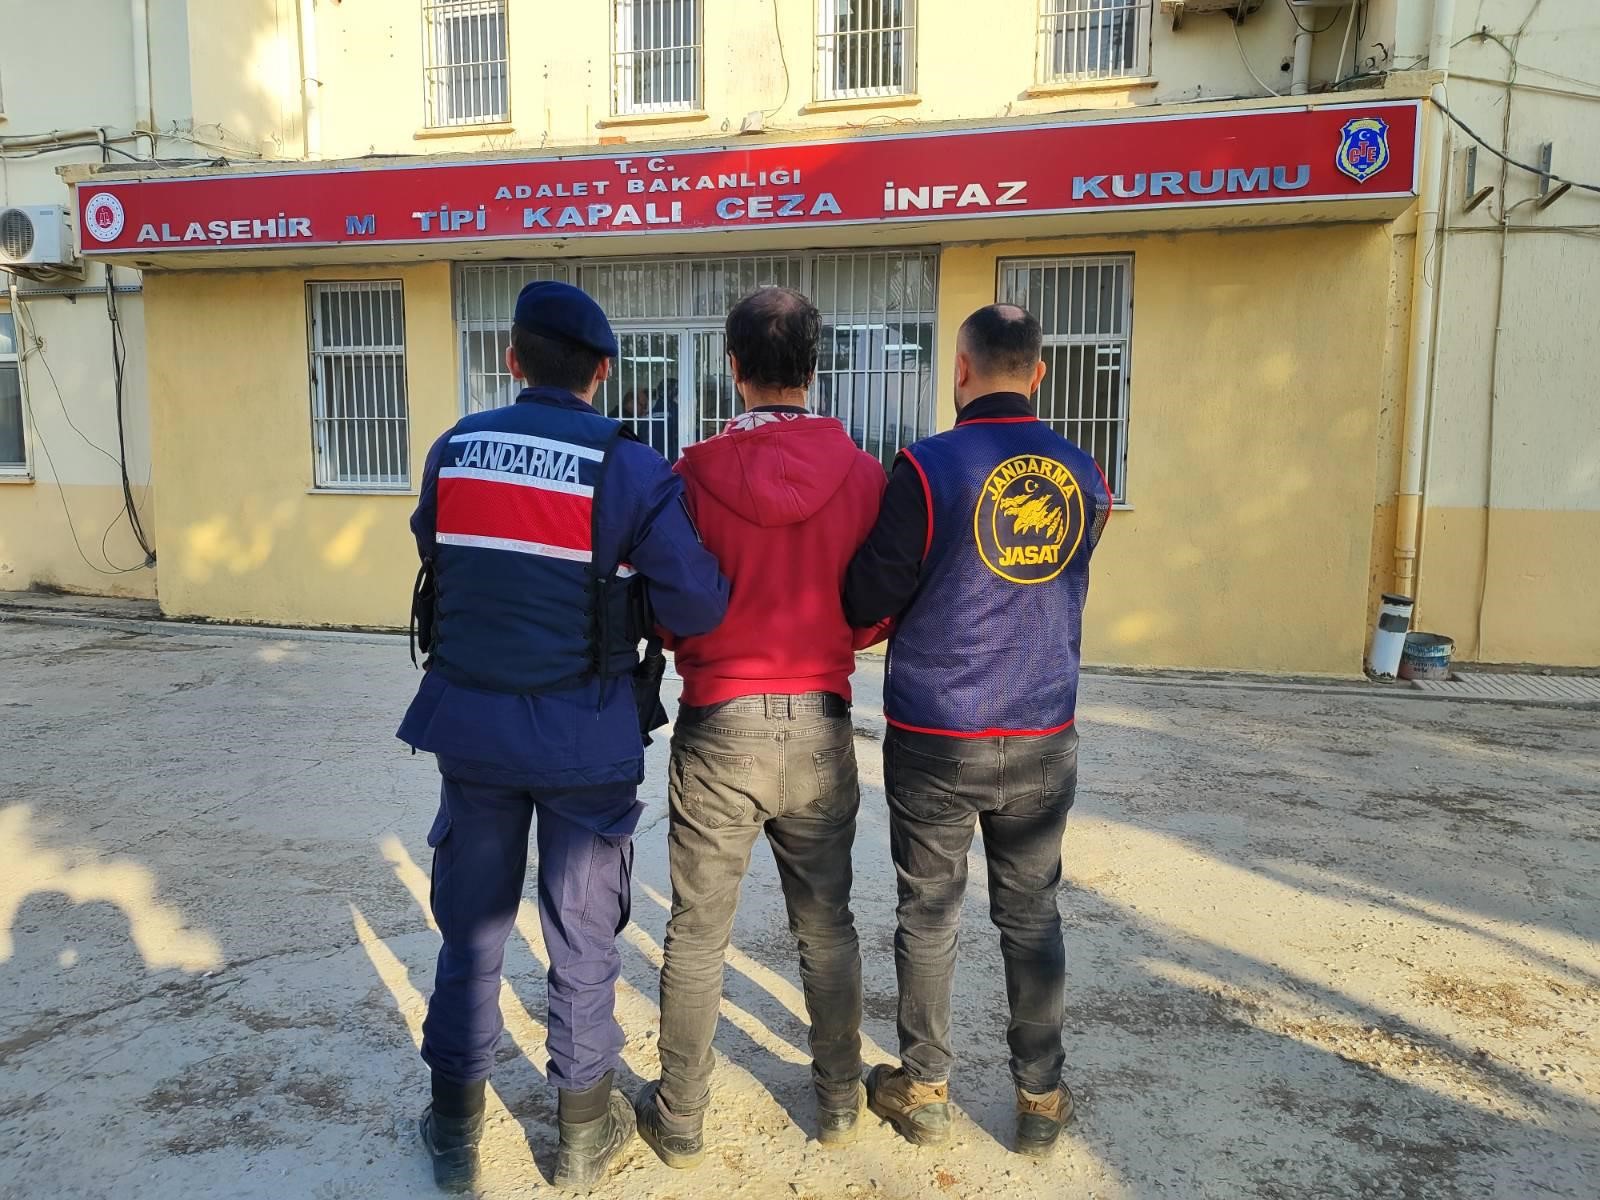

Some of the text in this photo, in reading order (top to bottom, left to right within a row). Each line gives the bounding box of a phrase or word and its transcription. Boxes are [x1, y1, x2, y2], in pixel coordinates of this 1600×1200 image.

[495, 166, 801, 200] ADALET BAKANLIĞI
[615, 158, 674, 174] T. C.
[136, 212, 313, 245] ALAŞEHİR
[345, 214, 375, 235] M
[412, 204, 487, 232] TİPİ
[522, 201, 682, 228] KAPALI
[716, 192, 842, 220] CEZA
[883, 181, 1028, 211] İNFAZ
[1072, 165, 1310, 201] KURUMU
[455, 441, 580, 484] JANDARMA
[987, 458, 1076, 501] JANDARMA
[999, 545, 1061, 566] JASAT
